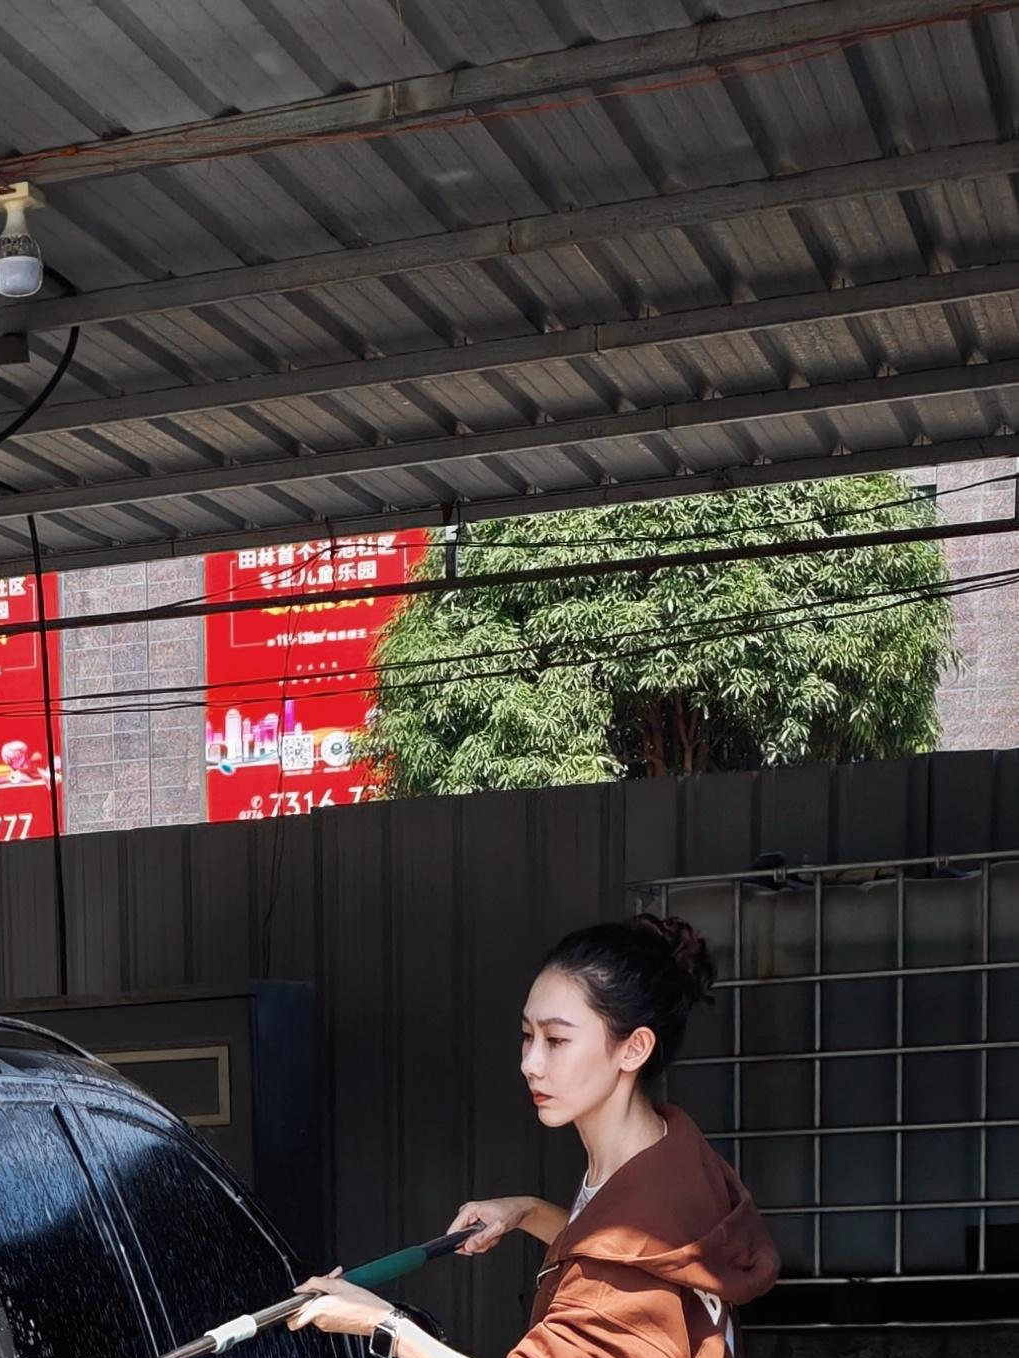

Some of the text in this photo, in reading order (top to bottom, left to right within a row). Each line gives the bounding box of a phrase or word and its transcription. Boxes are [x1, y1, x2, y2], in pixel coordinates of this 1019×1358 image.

[259, 560, 377, 589] 专业儿童乐园
[269, 788, 335, 817] 7316
